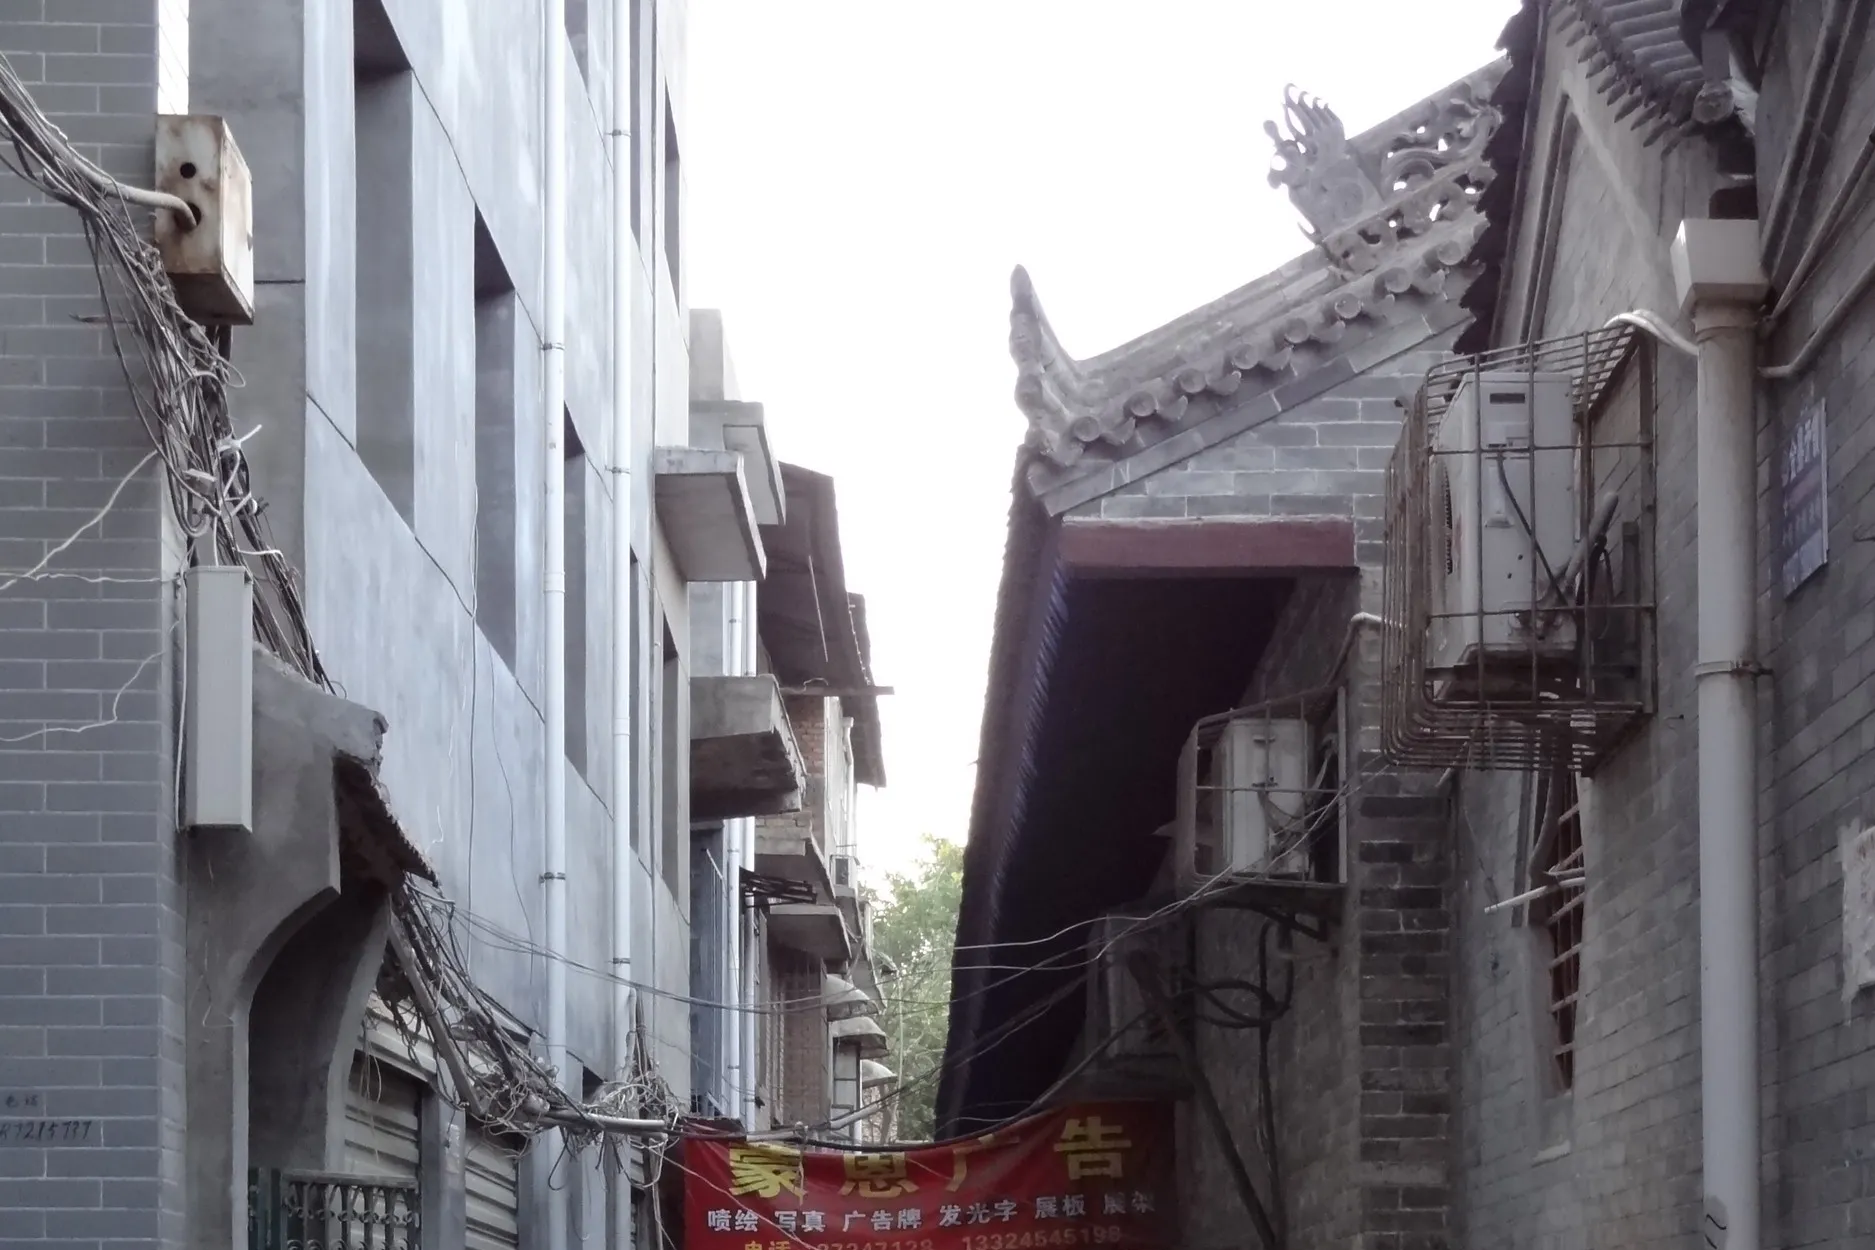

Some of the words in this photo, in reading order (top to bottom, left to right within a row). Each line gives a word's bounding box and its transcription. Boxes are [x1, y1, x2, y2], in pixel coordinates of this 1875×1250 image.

[707, 1208, 760, 1233] 喷绘
[774, 1209, 827, 1233] 写真
[841, 1207, 923, 1233] 广告牌
[938, 1199, 1018, 1228] 发光字
[1034, 1193, 1087, 1220] 展板
